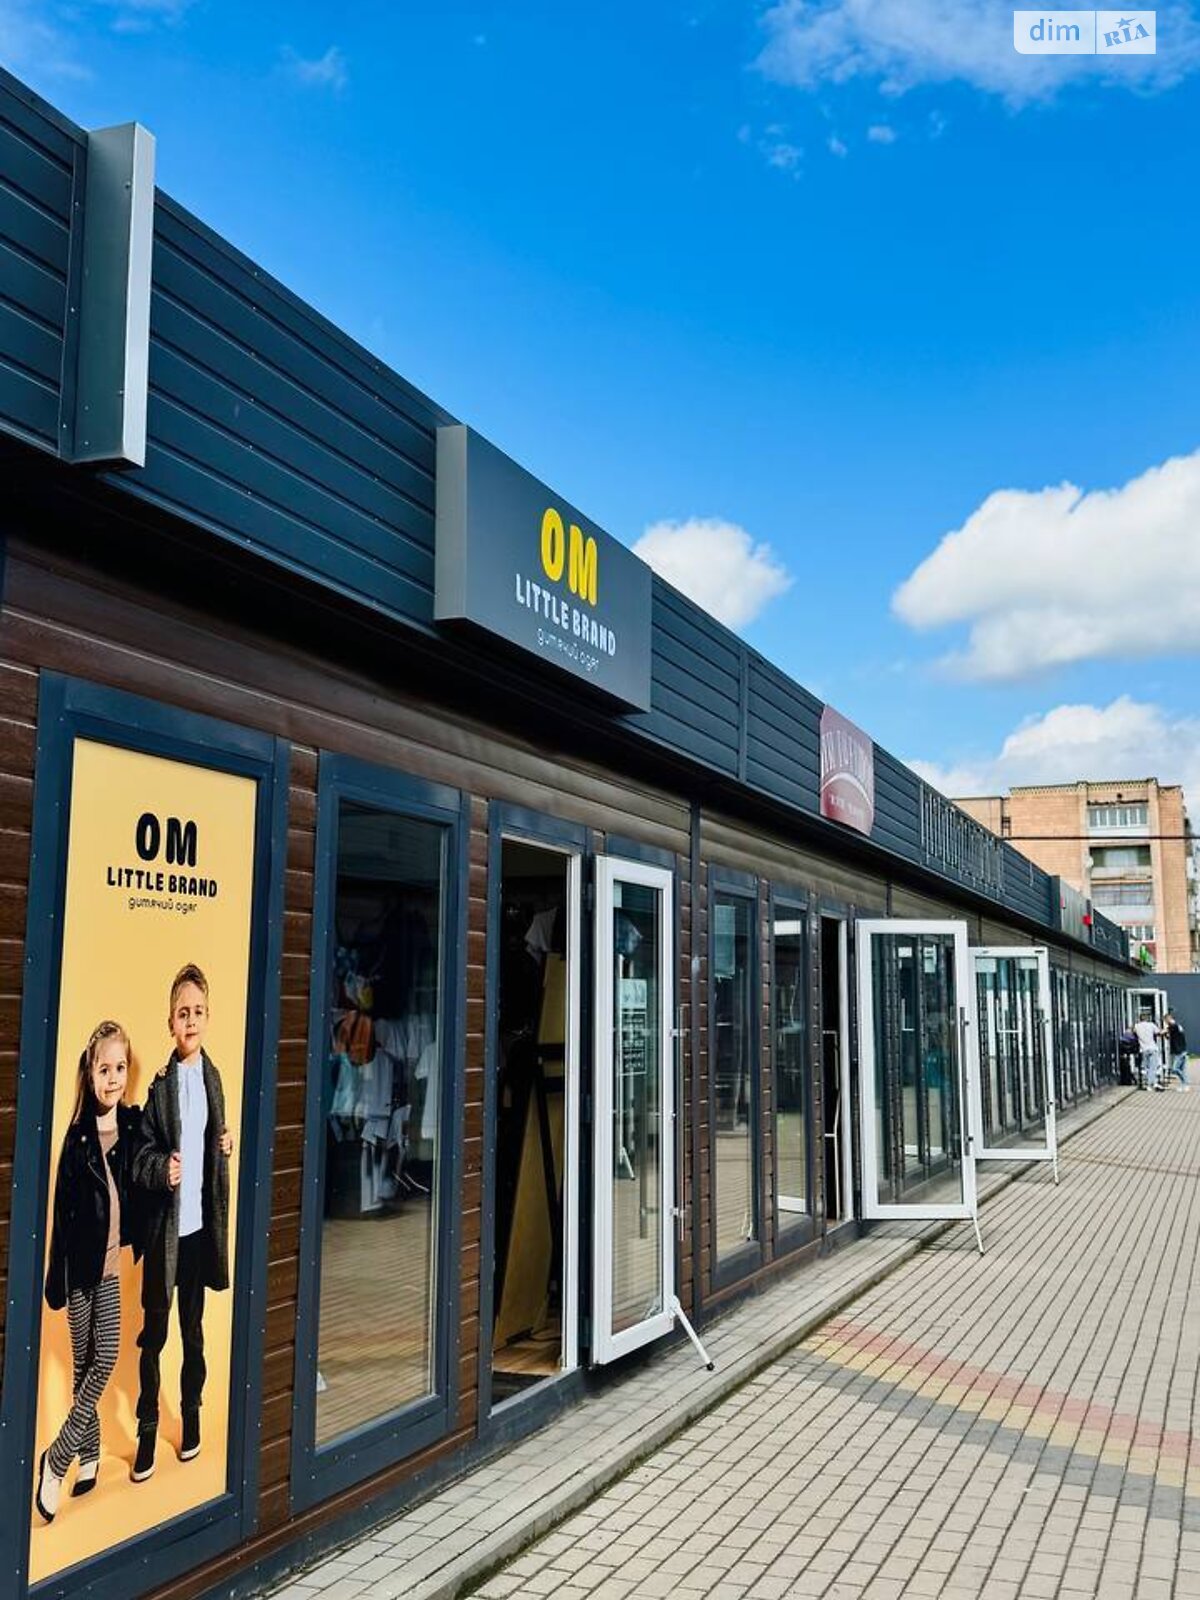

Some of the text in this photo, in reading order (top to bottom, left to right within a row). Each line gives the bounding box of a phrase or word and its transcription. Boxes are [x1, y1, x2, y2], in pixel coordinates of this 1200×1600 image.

[541, 508, 598, 607] OM
[515, 573, 616, 657] LITTLE BRAND
[135, 812, 198, 868] OM
[106, 866, 218, 898] LITTLE BRAND
